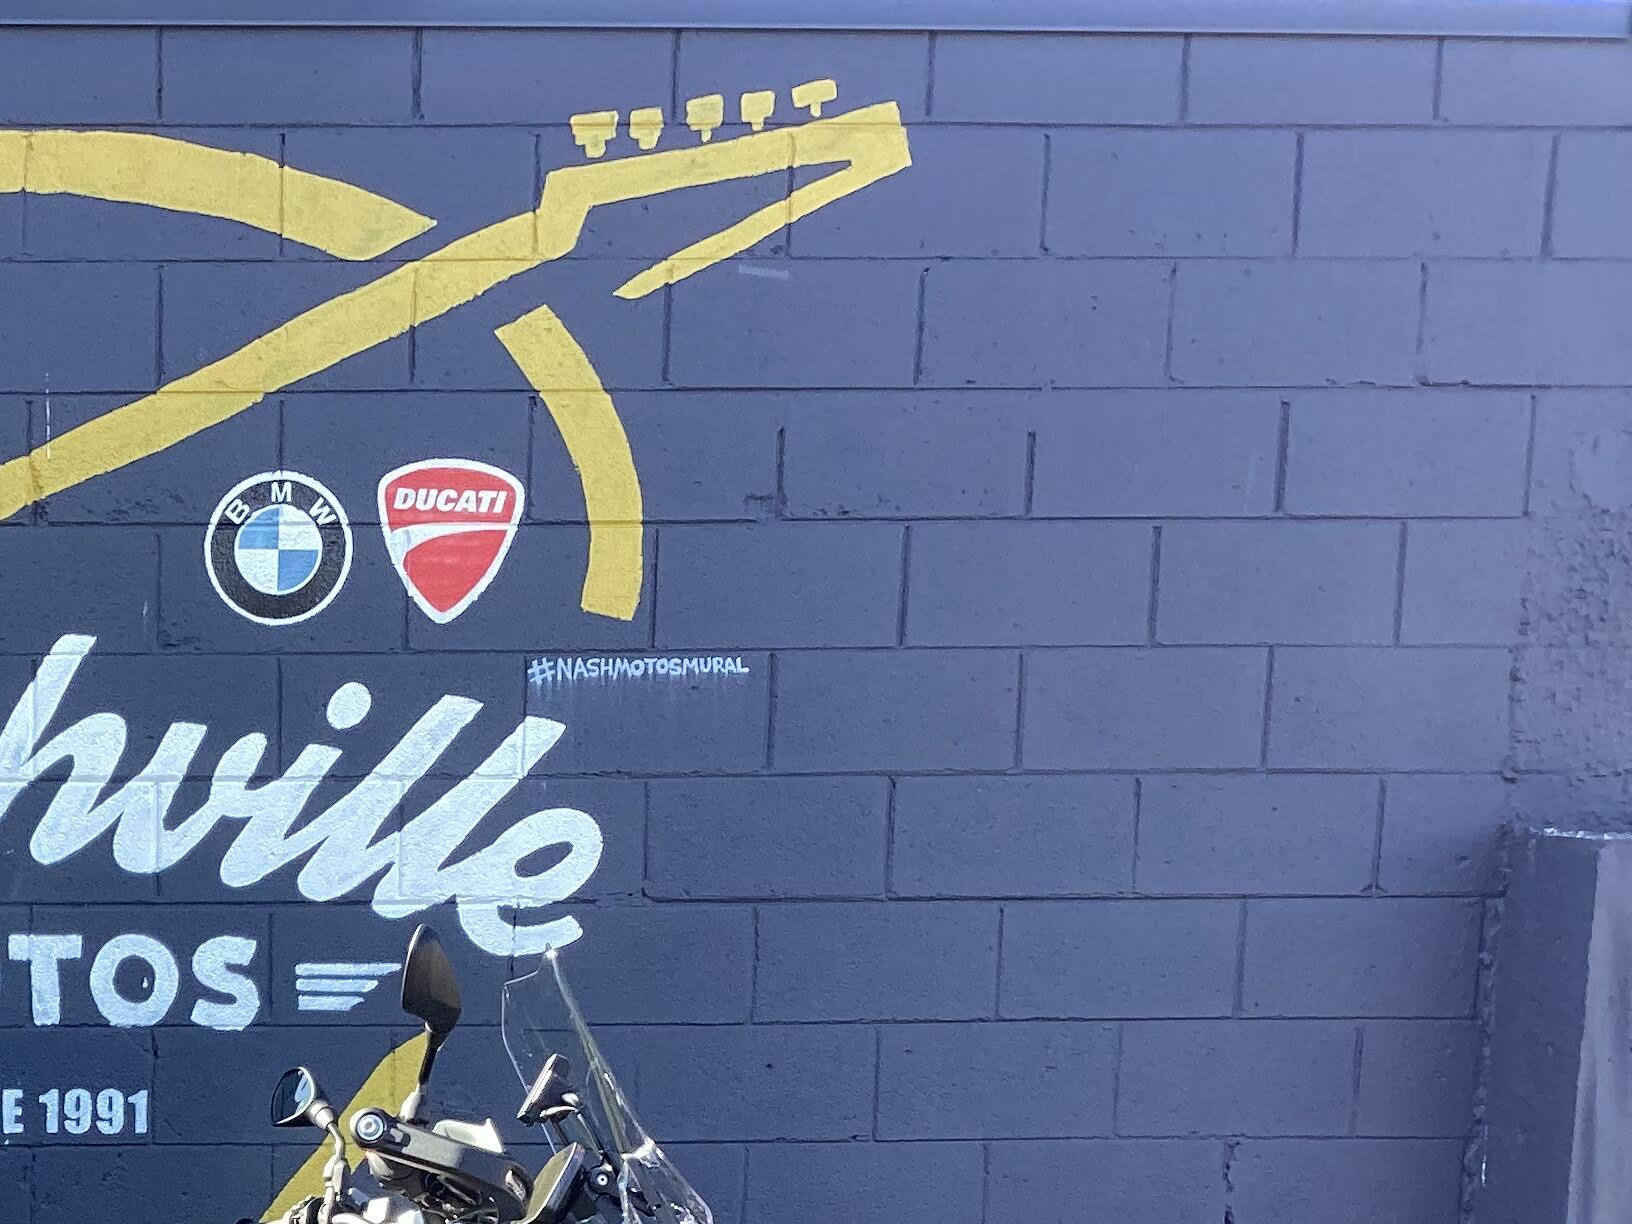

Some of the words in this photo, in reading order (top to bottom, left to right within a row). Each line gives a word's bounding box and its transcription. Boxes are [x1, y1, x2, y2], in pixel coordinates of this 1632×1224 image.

[224, 482, 335, 525] BMW
[393, 488, 508, 514] DUCATI
[527, 656, 750, 685] #NASHMOTOSMURAL
[38, 1087, 149, 1134] 1991
